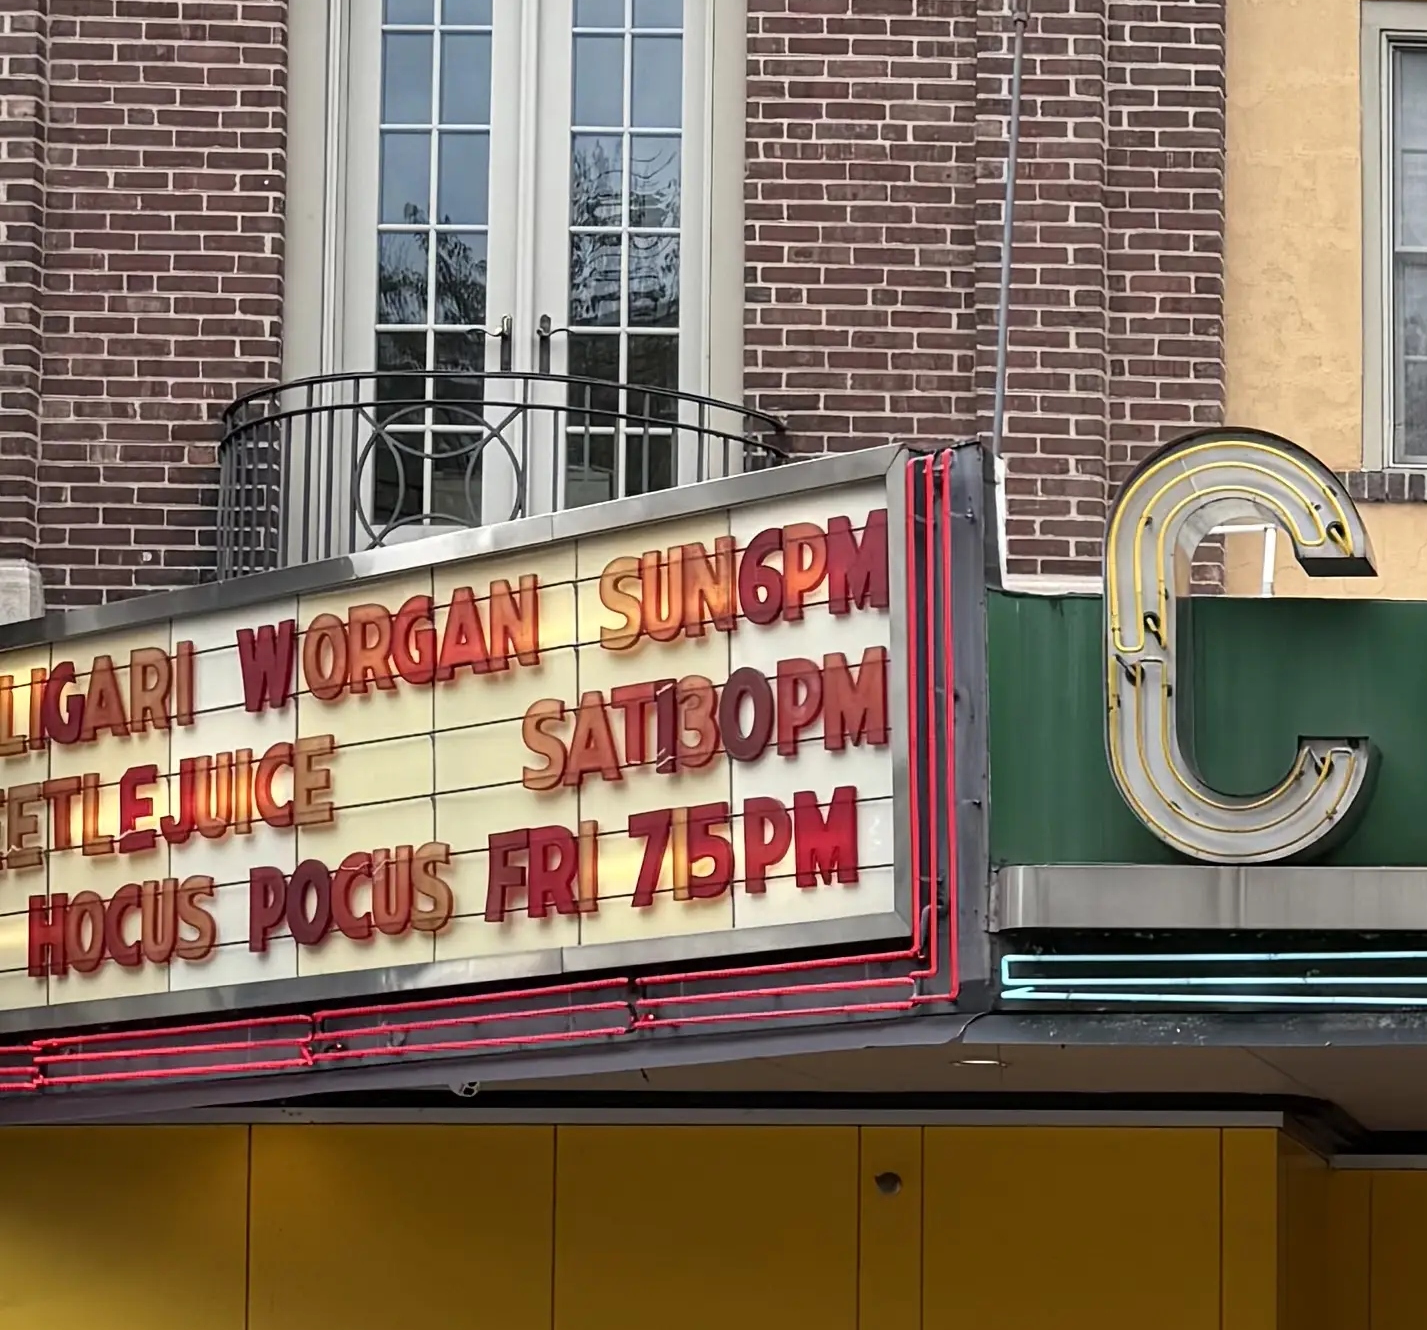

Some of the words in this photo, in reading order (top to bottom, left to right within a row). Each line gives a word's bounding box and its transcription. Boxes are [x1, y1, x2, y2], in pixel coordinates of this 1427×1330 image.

[0, 733, 335, 876] ETLEJUICE
[28, 874, 217, 978] HOCUS
[249, 841, 453, 953] POCUS
[484, 819, 599, 924] FRI
